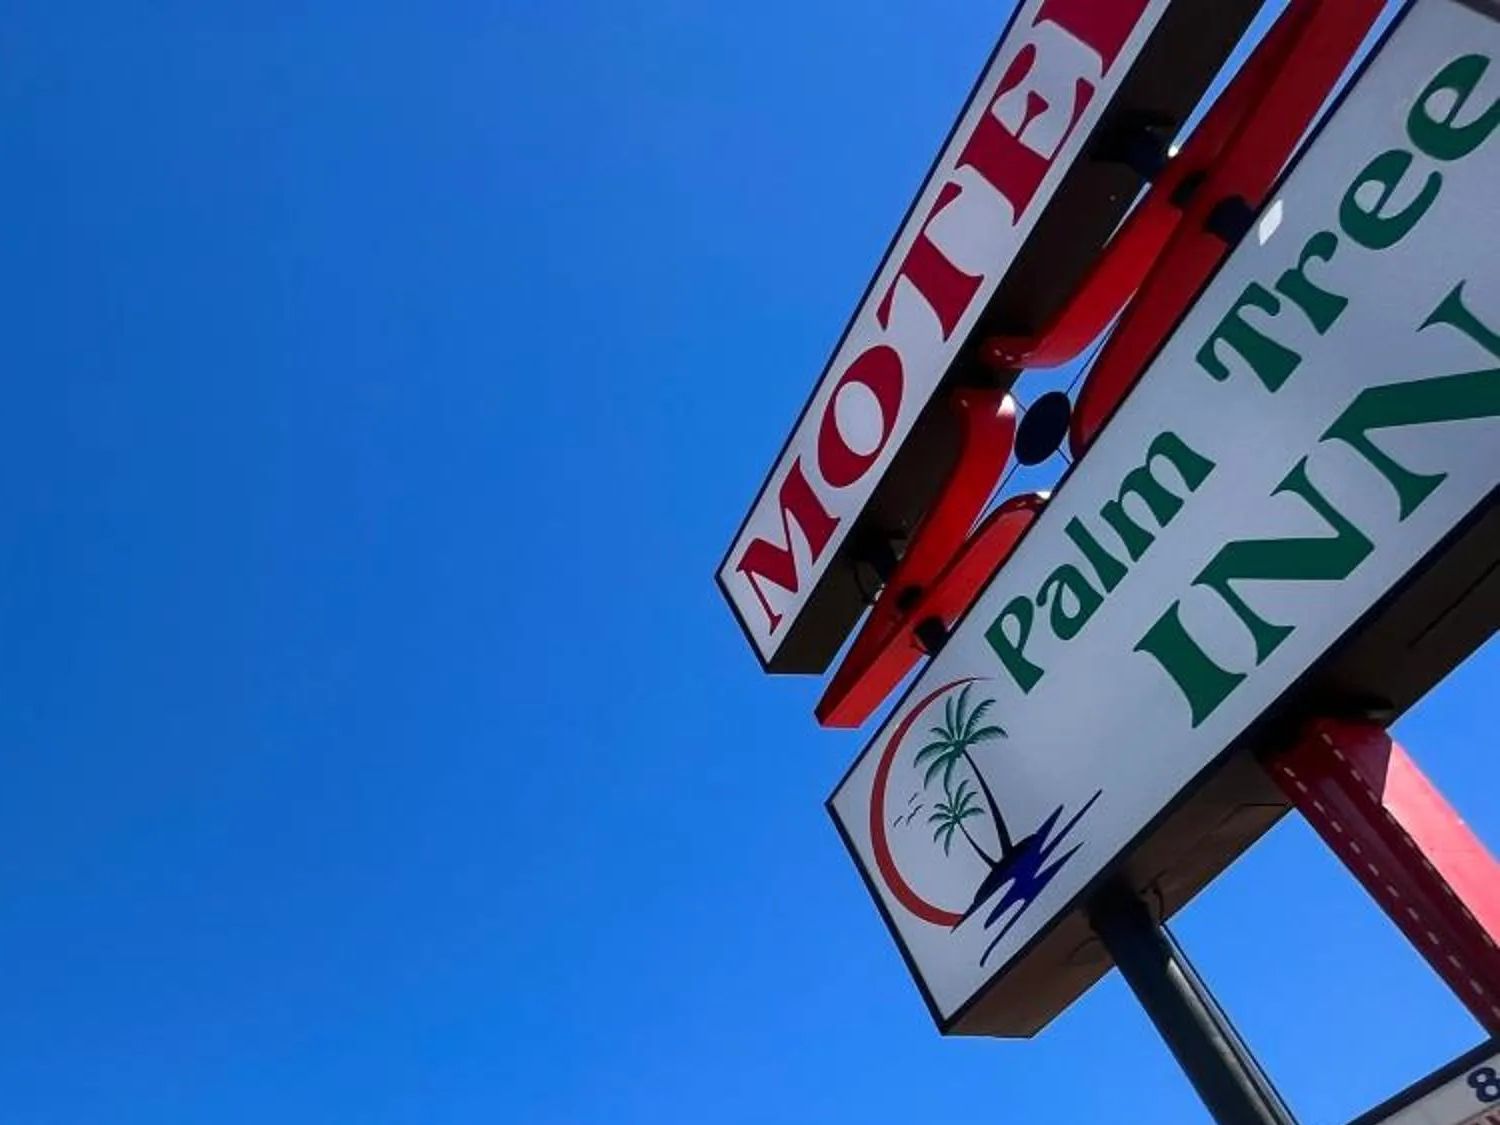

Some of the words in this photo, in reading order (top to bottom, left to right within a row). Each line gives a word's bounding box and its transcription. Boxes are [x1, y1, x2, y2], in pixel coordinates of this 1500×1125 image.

[984, 431, 1217, 694] Palm
[1195, 53, 1500, 393] Tree
[1132, 279, 1500, 728] INN
